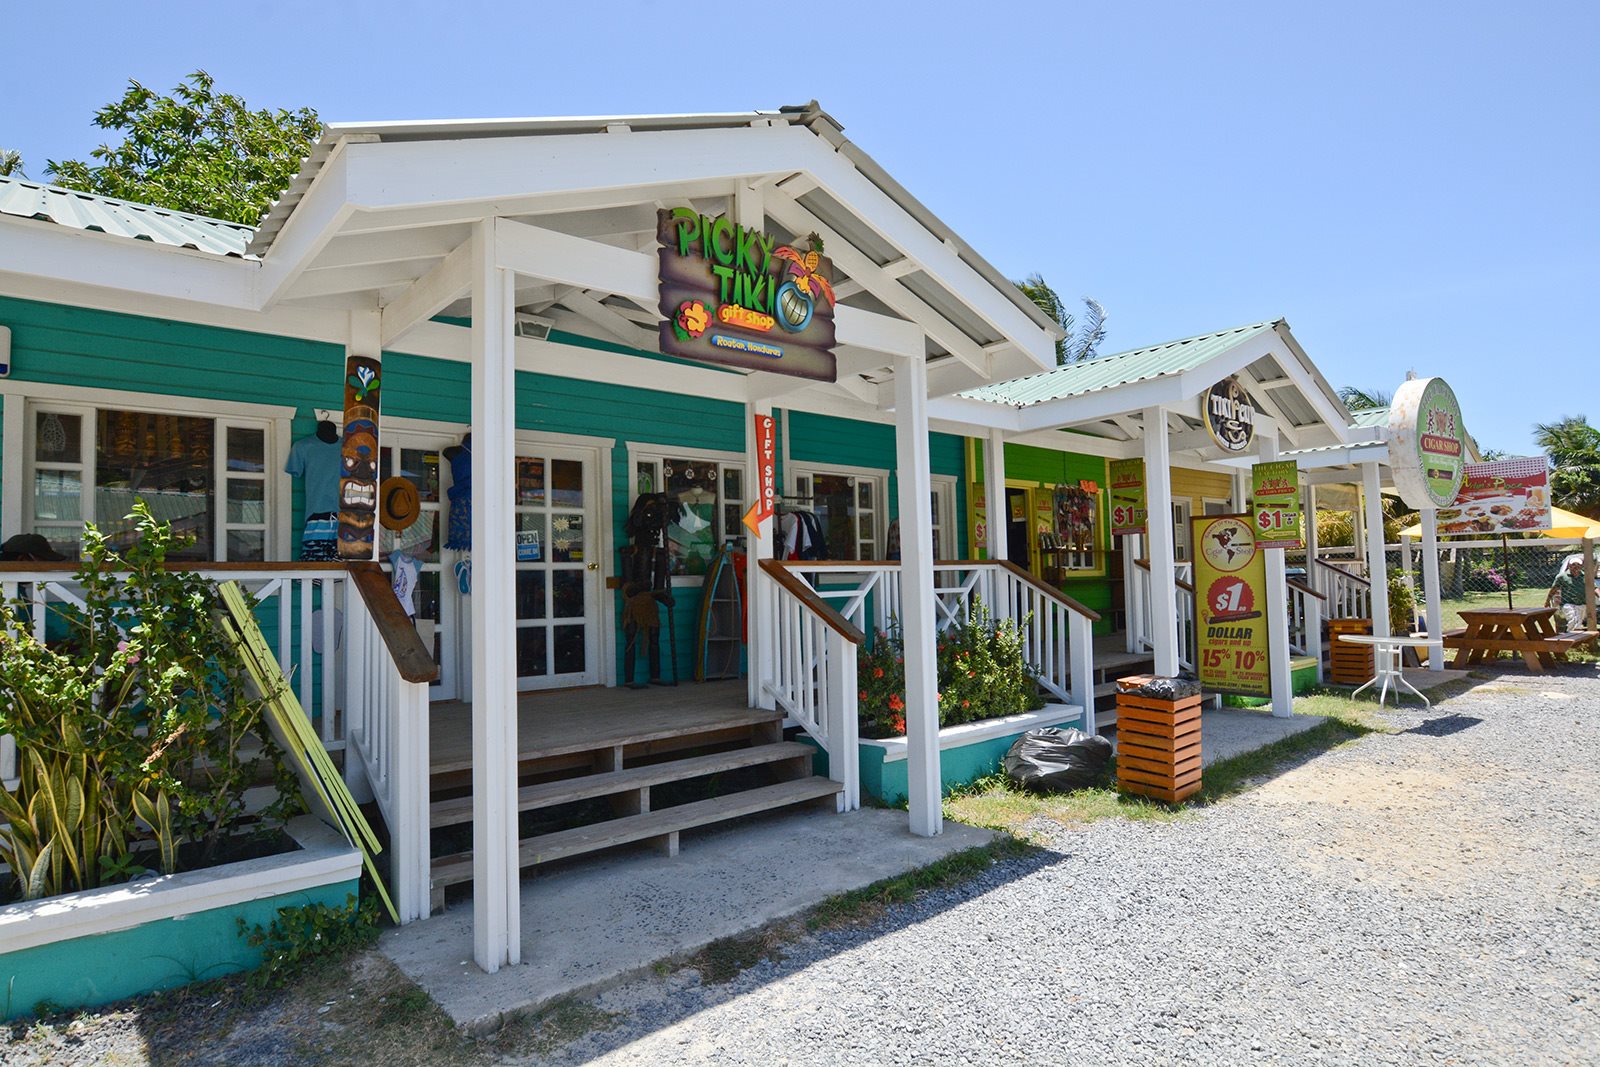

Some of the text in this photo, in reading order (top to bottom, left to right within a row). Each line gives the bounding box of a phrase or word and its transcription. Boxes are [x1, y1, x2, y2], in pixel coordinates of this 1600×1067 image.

[671, 207, 775, 279] PICKY
[712, 264, 775, 315] TIKI
[721, 303, 775, 330] gift shop
[747, 342, 782, 358] Honduras
[1424, 437, 1460, 454] CIGAR SHOP
[763, 418, 775, 511] GIFT SHOP
[1114, 506, 1134, 525] $1
[1258, 510, 1281, 529] $1
[517, 532, 538, 544] OPEN
[1206, 626, 1253, 639] DOLLAR
[1202, 649, 1265, 670] 15% 10%
